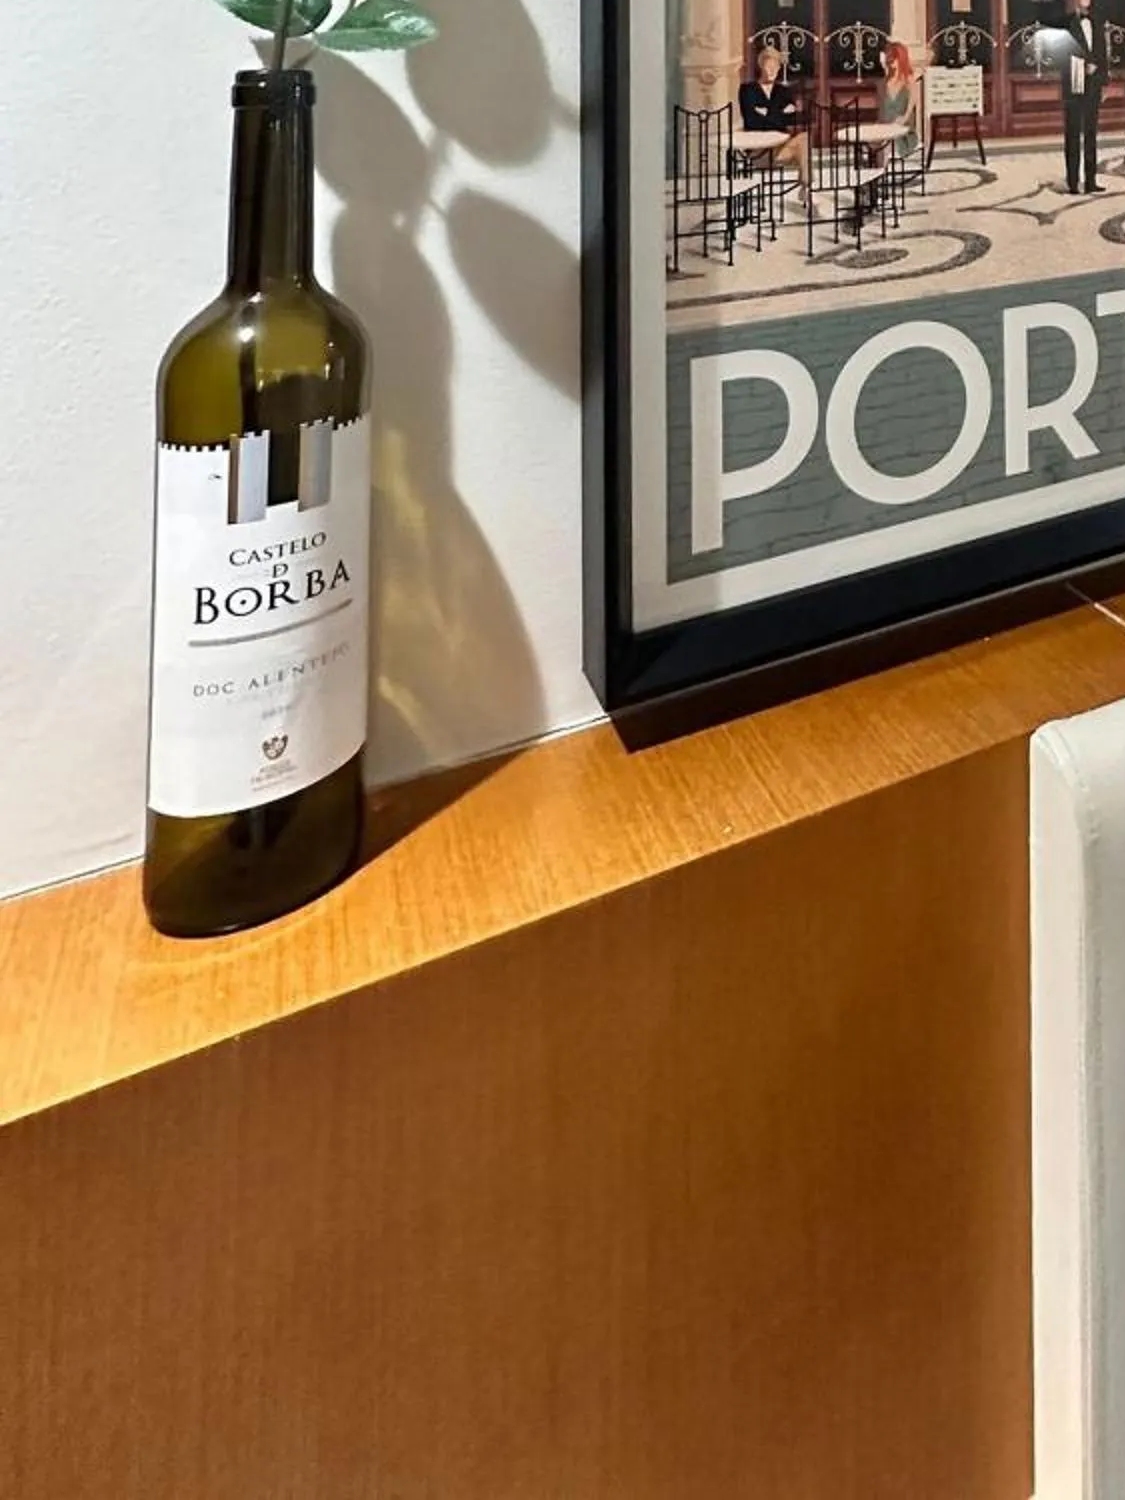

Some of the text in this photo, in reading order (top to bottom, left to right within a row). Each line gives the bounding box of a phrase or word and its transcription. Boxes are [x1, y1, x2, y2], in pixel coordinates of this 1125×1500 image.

[229, 530, 327, 566] CASTELO
[194, 558, 351, 625] BORBA
[193, 681, 235, 698] DOC
